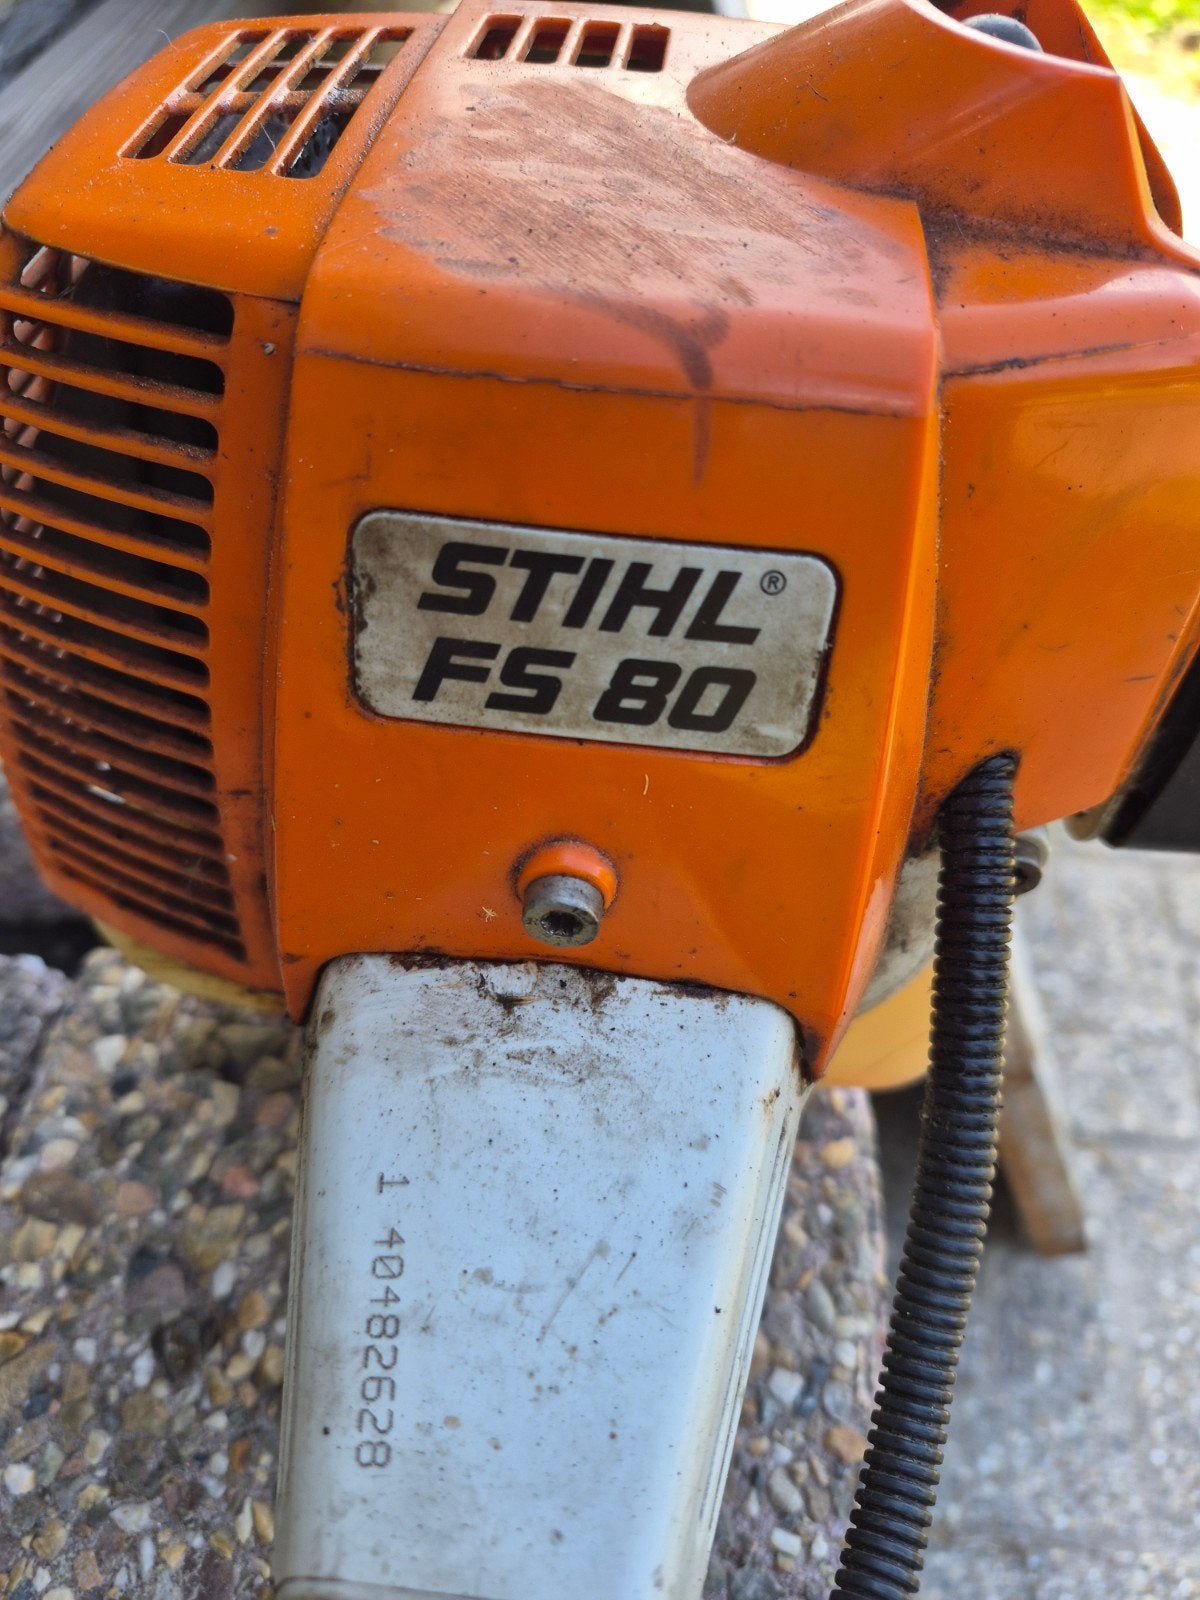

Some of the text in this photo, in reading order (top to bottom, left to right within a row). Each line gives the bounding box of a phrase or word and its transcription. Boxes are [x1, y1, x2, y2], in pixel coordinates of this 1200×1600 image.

[412, 636, 758, 733] FS 80
[354, 1172, 410, 1468] 1 40482628
